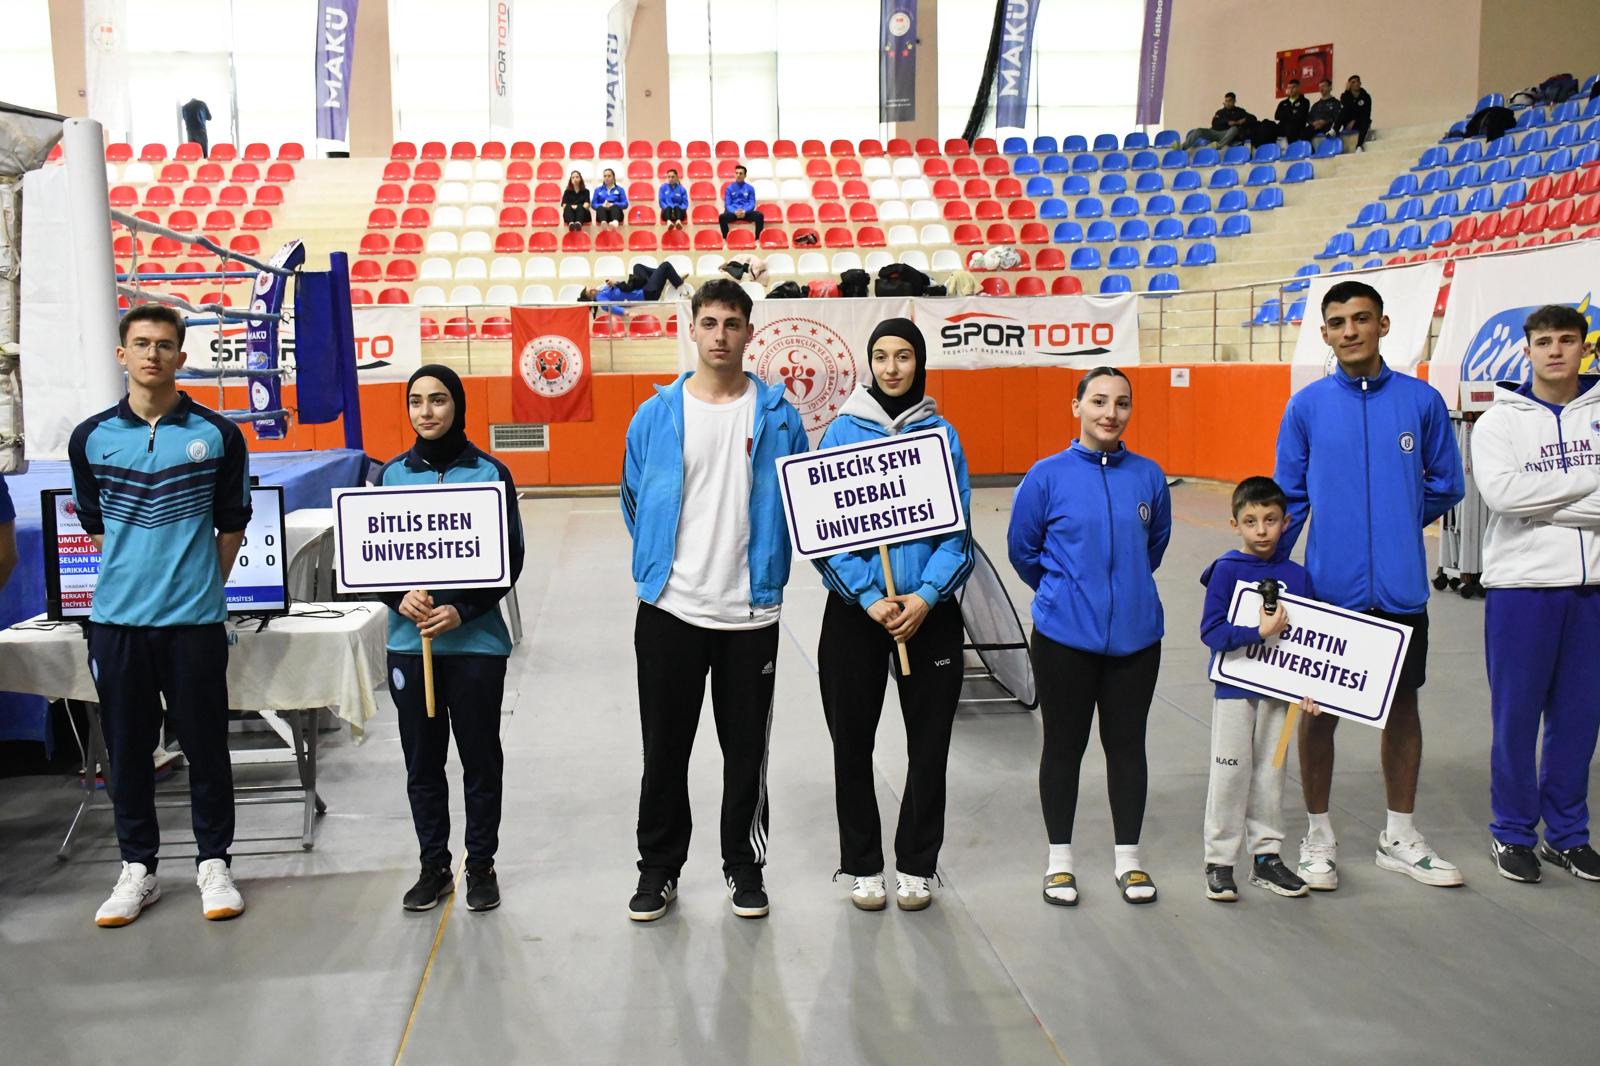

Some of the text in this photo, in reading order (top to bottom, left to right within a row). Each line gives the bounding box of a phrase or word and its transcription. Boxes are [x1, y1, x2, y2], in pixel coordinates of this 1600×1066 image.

[323, 6, 349, 108] MAKÜ
[999, 0, 1030, 97] MAKÜ
[606, 33, 619, 127] MAKÜ
[817, 346, 827, 358] VE
[824, 356, 836, 377] SPOR
[807, 447, 922, 486] BİLECİK ŞEYH
[833, 474, 907, 509] EDEBALİ
[367, 510, 472, 534] BİTLİS EREN
[816, 498, 935, 541] ÜNİVERSİTESİ
[58, 536, 82, 544] UMUT
[58, 545, 88, 554] KOCAELİ
[264, 534, 275, 547] 0
[362, 536, 481, 562] ÜNİVERSİTESİ
[59, 556, 89, 564] SELHAN
[60, 566, 96, 574] KIRIKKALE
[239, 554, 276, 567] 0 0
[61, 592, 86, 600] BERKAY
[1279, 624, 1348, 657] BARTIN
